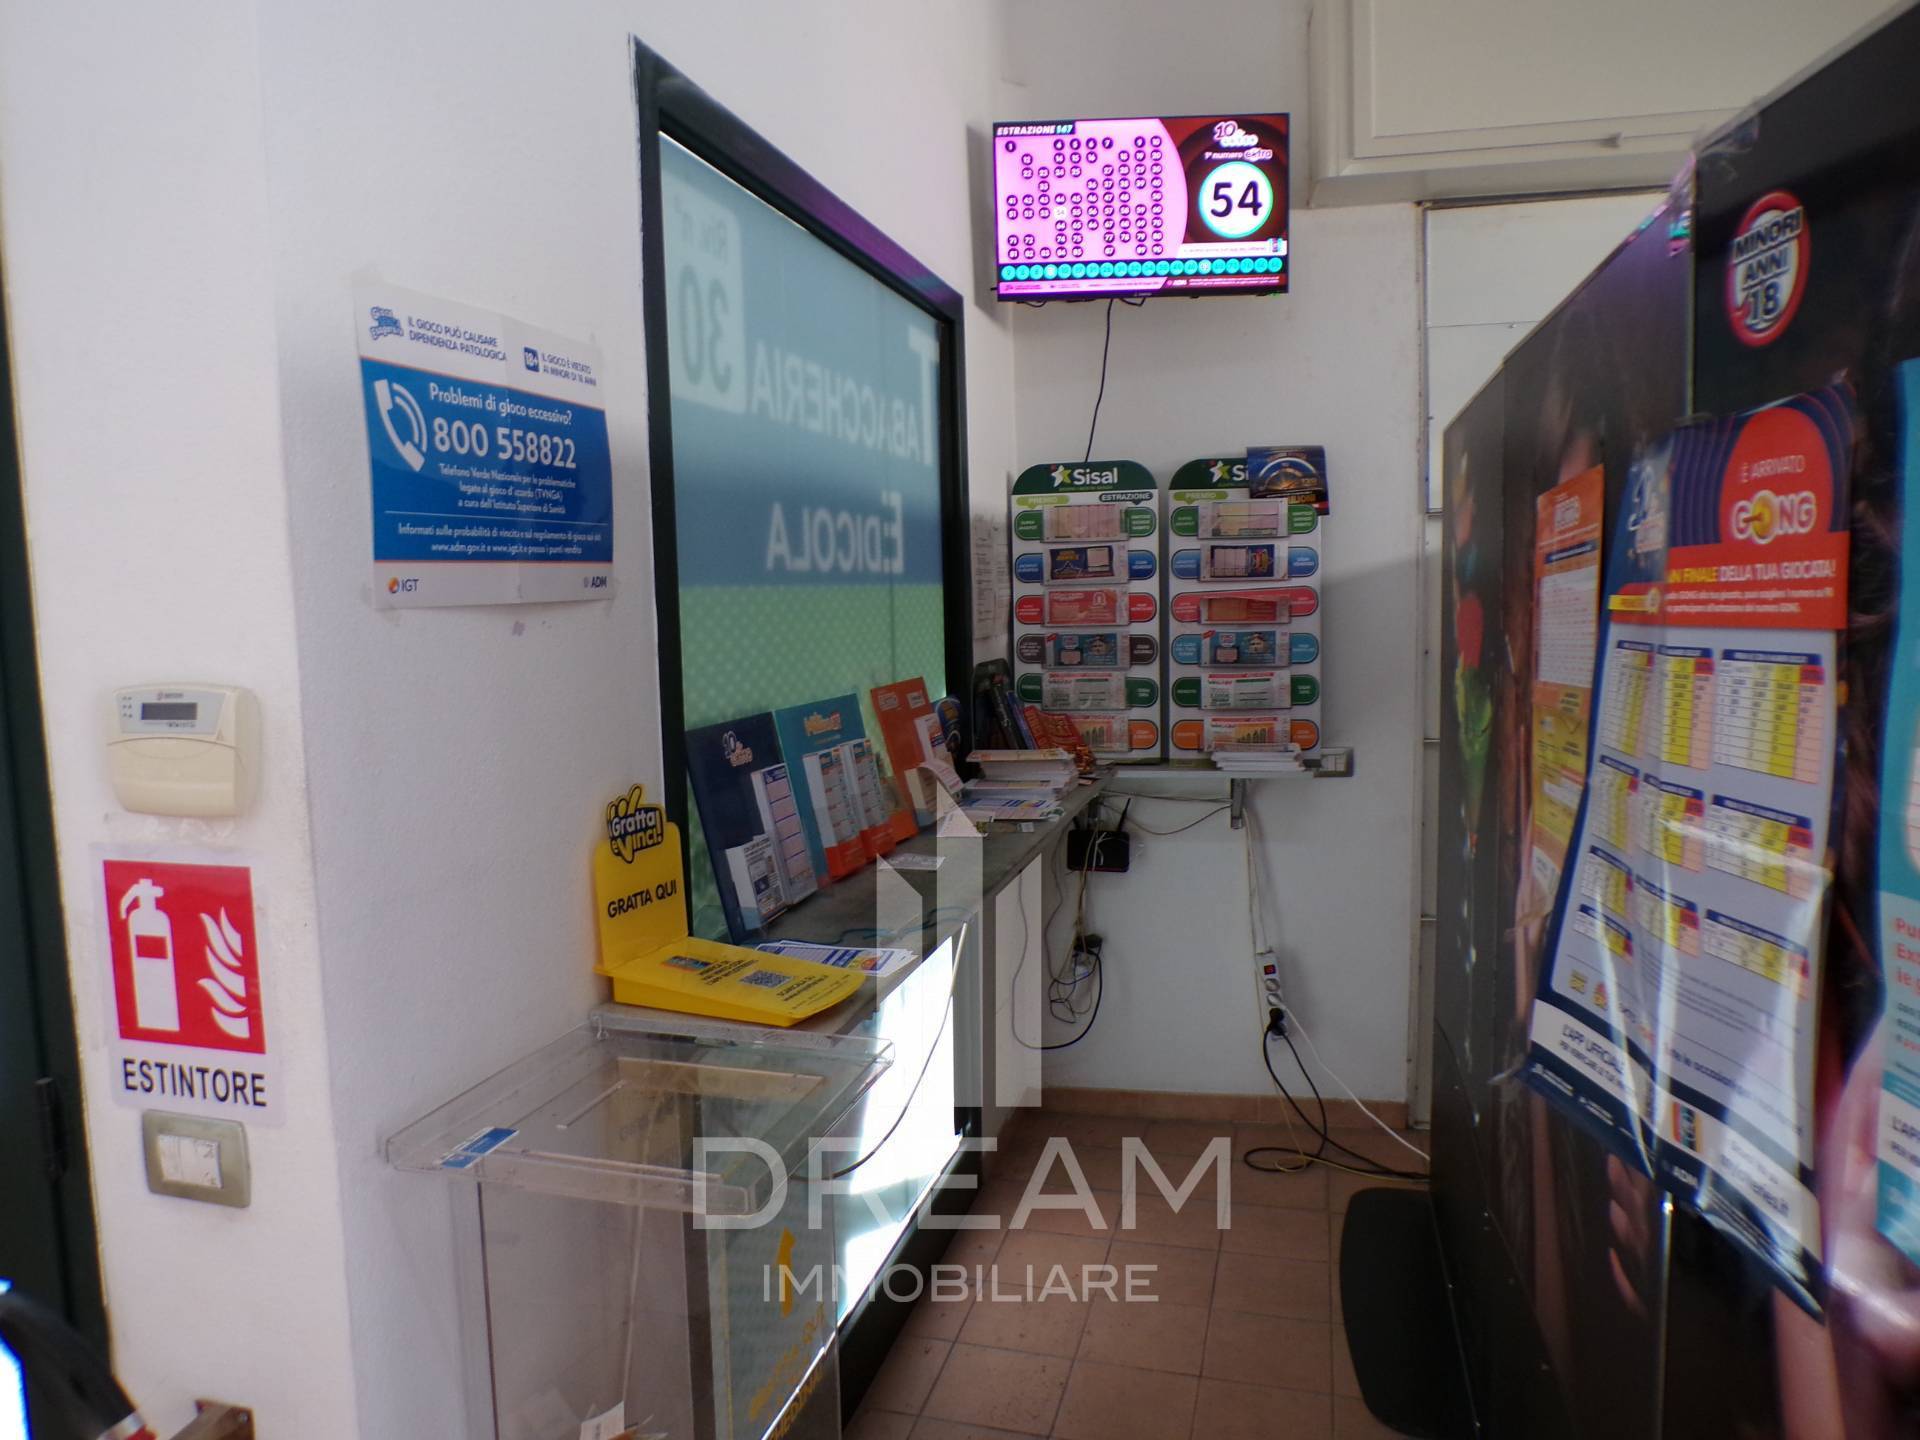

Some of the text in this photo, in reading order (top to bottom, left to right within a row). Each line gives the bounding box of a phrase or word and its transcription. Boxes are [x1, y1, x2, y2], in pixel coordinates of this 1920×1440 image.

[997, 125, 1055, 136] ESTRAZIONE
[1211, 180, 1262, 217] 54
[1735, 208, 1802, 259] MINORI
[1745, 248, 1788, 284] ANNI
[1748, 281, 1780, 321] 18
[409, 330, 507, 361] DIPENDENZA PATOLOGICA
[416, 318, 443, 334] GIOCO
[463, 330, 498, 347] CAUSARE
[429, 382, 573, 425] Problemi di gioco eccessivo?
[433, 417, 577, 469] 800 558822
[439, 463, 470, 477] Telefono
[1073, 467, 1118, 486] Sisal
[1752, 455, 1805, 478] ARRIVATO
[1101, 493, 1151, 501] ESTRAZIONE
[398, 522, 434, 535] Informati
[1732, 490, 1817, 544] GONG
[590, 576, 608, 588] ADM
[1719, 564, 1753, 582] DELLA
[1755, 563, 1779, 580] TUA
[1780, 559, 1837, 580] GIOCATA!
[401, 579, 419, 592] IGT
[611, 810, 657, 838] Gratta
[608, 879, 677, 918] GRATTA QUI
[123, 1057, 268, 1108] ESTINTORE
